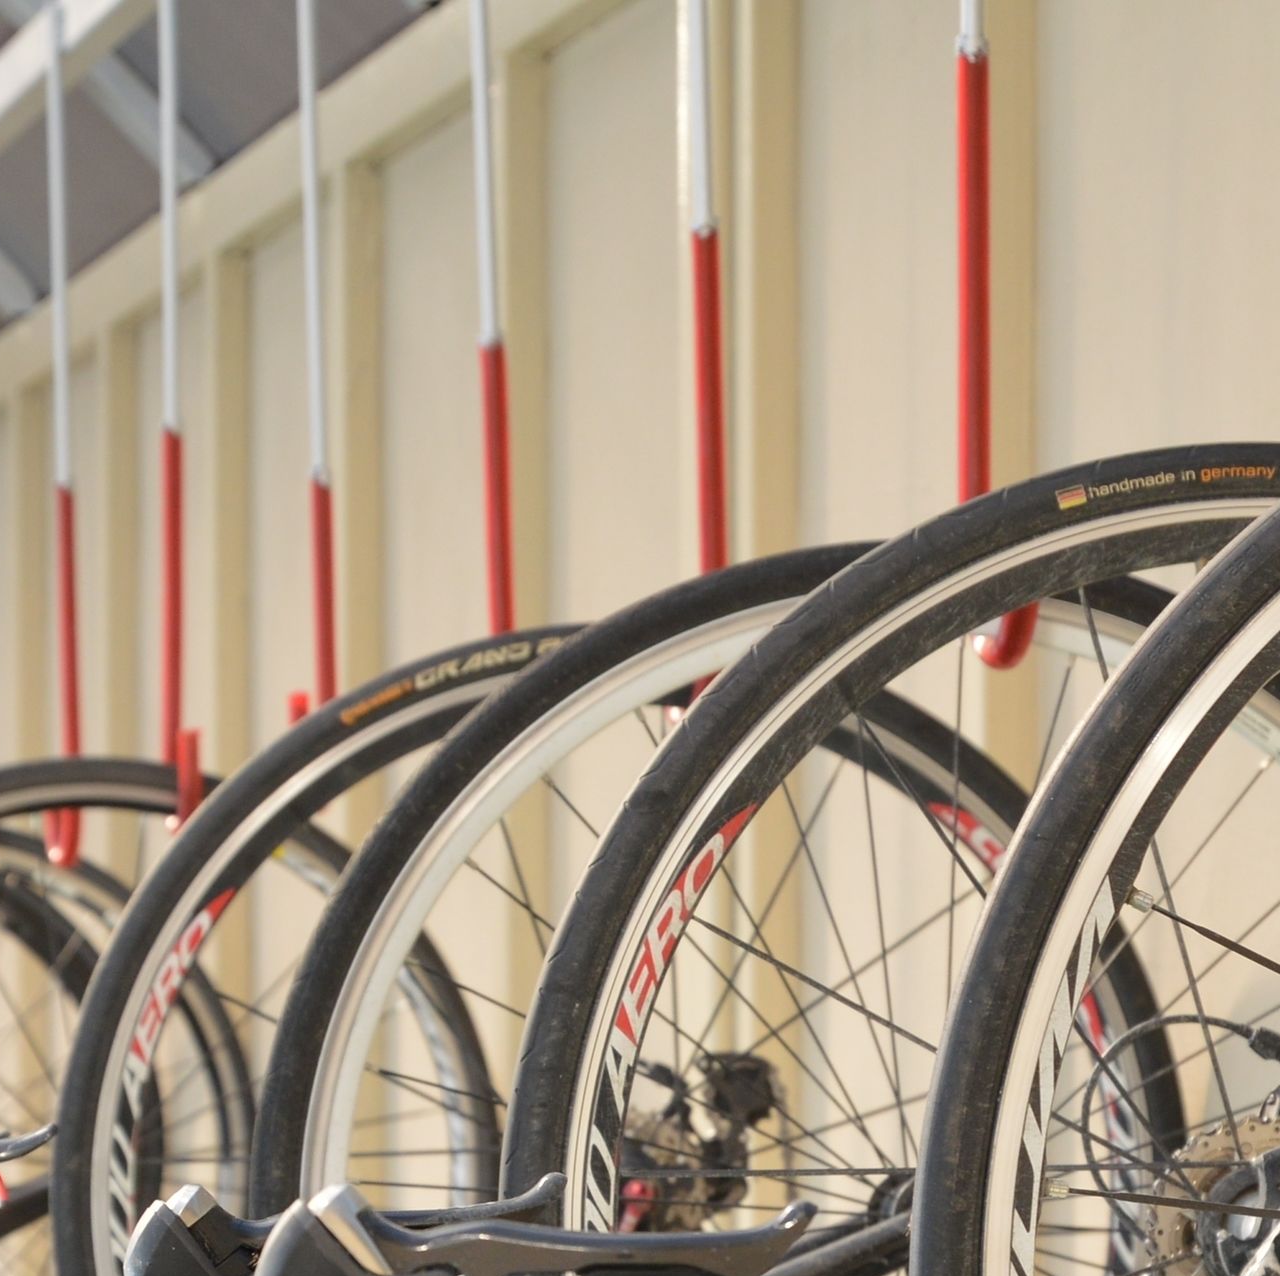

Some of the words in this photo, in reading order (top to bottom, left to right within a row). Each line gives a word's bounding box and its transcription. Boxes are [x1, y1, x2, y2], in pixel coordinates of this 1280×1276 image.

[1088, 470, 1175, 499] handmade
[1180, 468, 1197, 482] in
[1200, 464, 1276, 483] germany
[413, 640, 532, 692] GRAND
